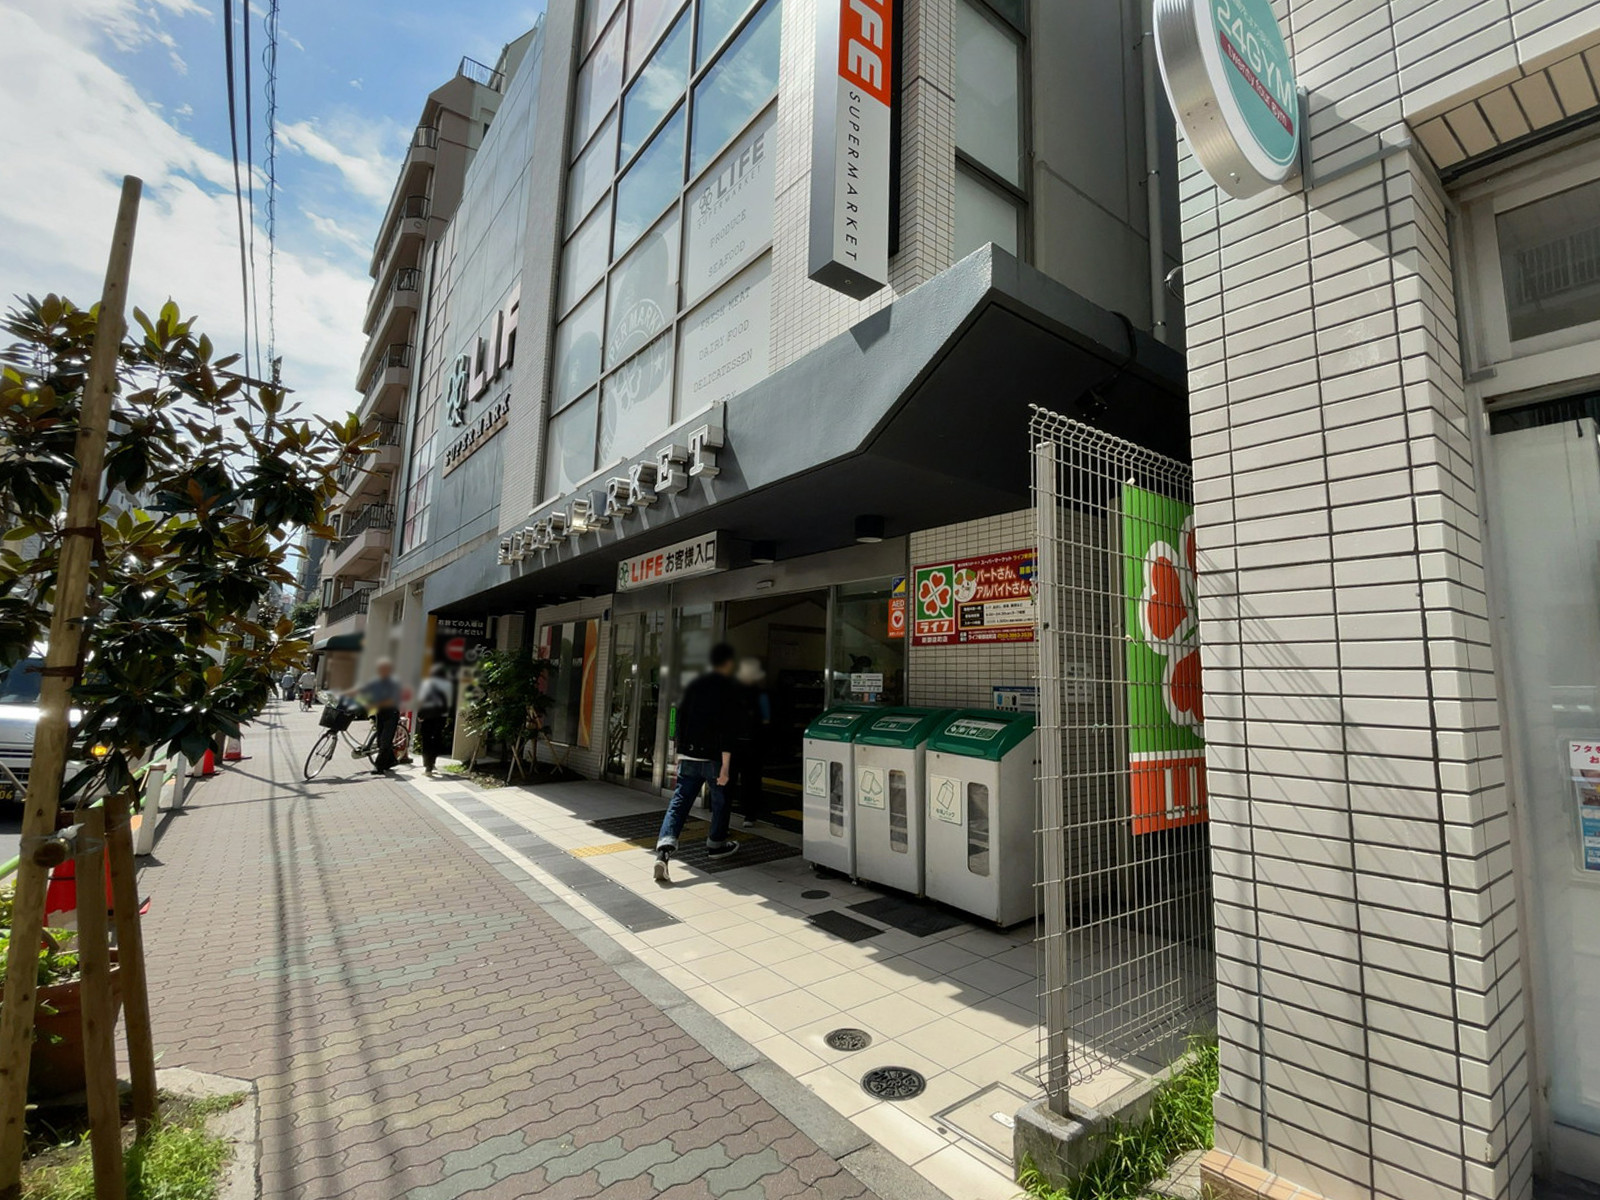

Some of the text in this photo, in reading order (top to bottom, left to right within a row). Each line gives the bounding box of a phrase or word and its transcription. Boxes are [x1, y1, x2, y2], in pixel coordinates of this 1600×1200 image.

[847, 0, 884, 91] FE
[716, 132, 765, 199] LIFE
[844, 90, 861, 261] SUPERMARKET
[709, 208, 747, 248] PRODUCE
[708, 239, 746, 278] SEAFOOD
[698, 319, 750, 361] DAIRY FOOD
[693, 347, 754, 393] DELICATESSEN
[631, 539, 716, 583] LIFE お客様入口
[920, 620, 950, 633] ライフ
